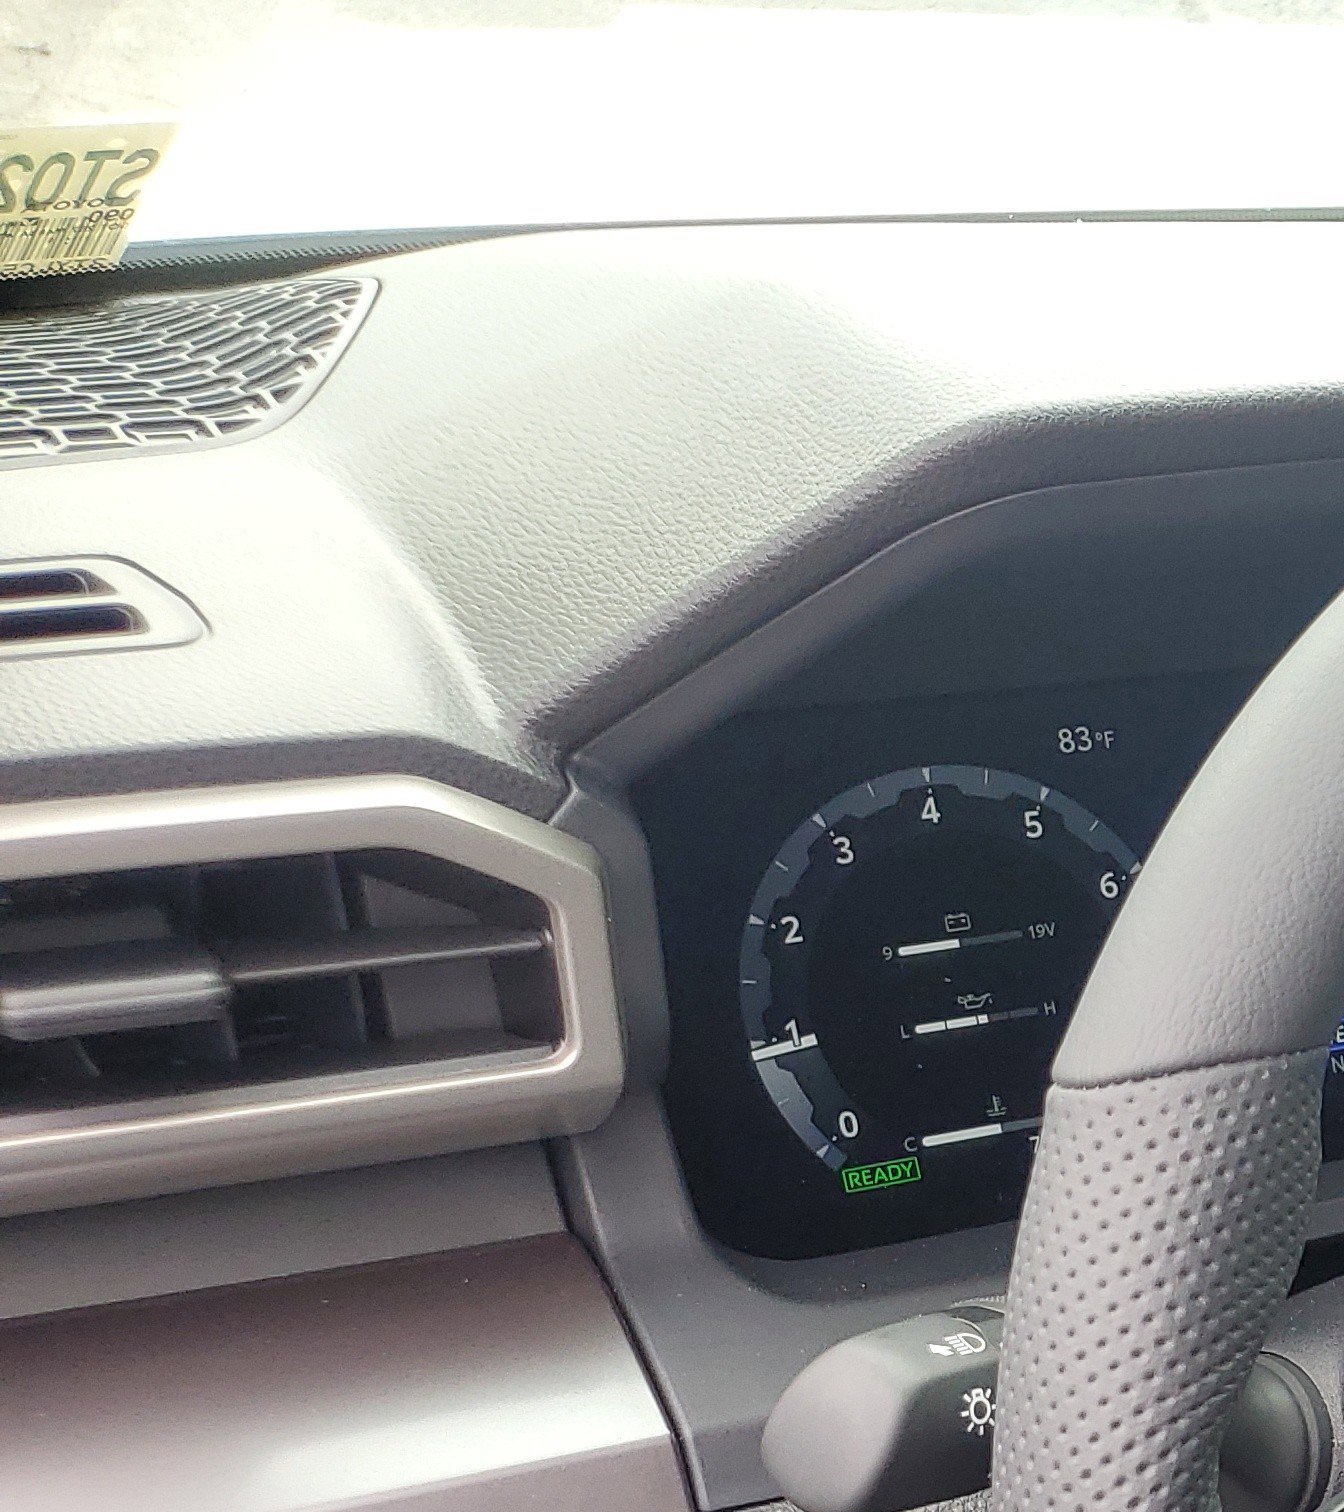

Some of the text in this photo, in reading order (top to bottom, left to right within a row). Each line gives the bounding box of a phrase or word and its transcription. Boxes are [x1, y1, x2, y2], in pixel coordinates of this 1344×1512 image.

[921, 796, 941, 825] 4
[1025, 810, 1044, 839] 5
[833, 835, 854, 865] 3
[1100, 873, 1119, 899] 6
[783, 916, 804, 945] 2
[882, 922, 1056, 961] 9 19V
[784, 1019, 801, 1048] 1
[901, 1001, 1057, 1040] L H
[838, 1111, 859, 1139] 0
[904, 1136, 917, 1153] C
[848, 1163, 914, 1189] READY
